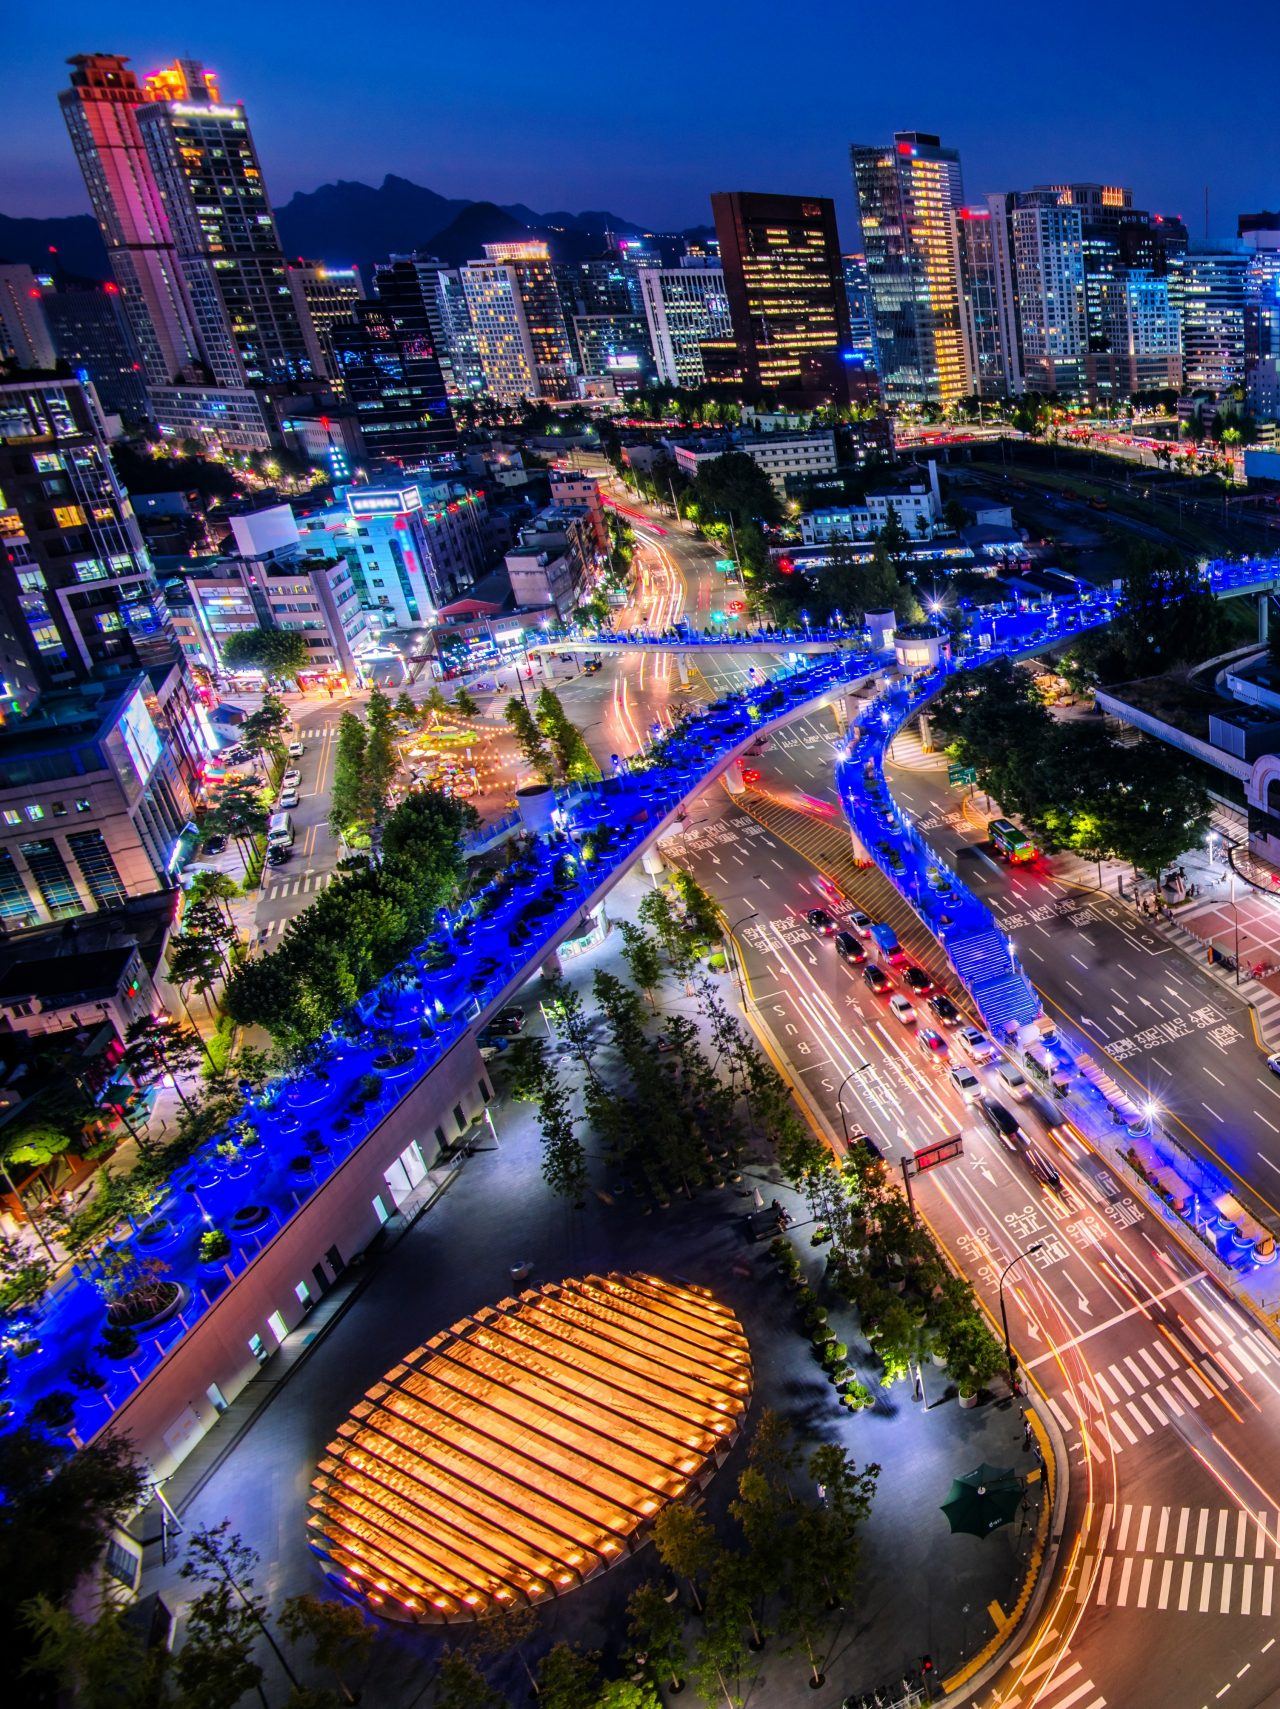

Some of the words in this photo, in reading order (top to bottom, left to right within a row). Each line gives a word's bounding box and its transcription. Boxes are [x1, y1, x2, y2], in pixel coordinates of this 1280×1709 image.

[1105, 907, 1154, 945] BUS
[772, 1004, 811, 1055] BUS
[1160, 1017, 1195, 1040] 서소문
[1187, 1006, 1222, 1029] 숭례문
[1103, 1037, 1143, 1062] 충정로역
[1133, 1027, 1169, 1049] 충정로
[1207, 1023, 1245, 1048] 서울역
[1005, 1205, 1047, 1240] 공덕동
[1104, 1198, 1146, 1230] 청파동
[1027, 1233, 1070, 1270] 만리동
